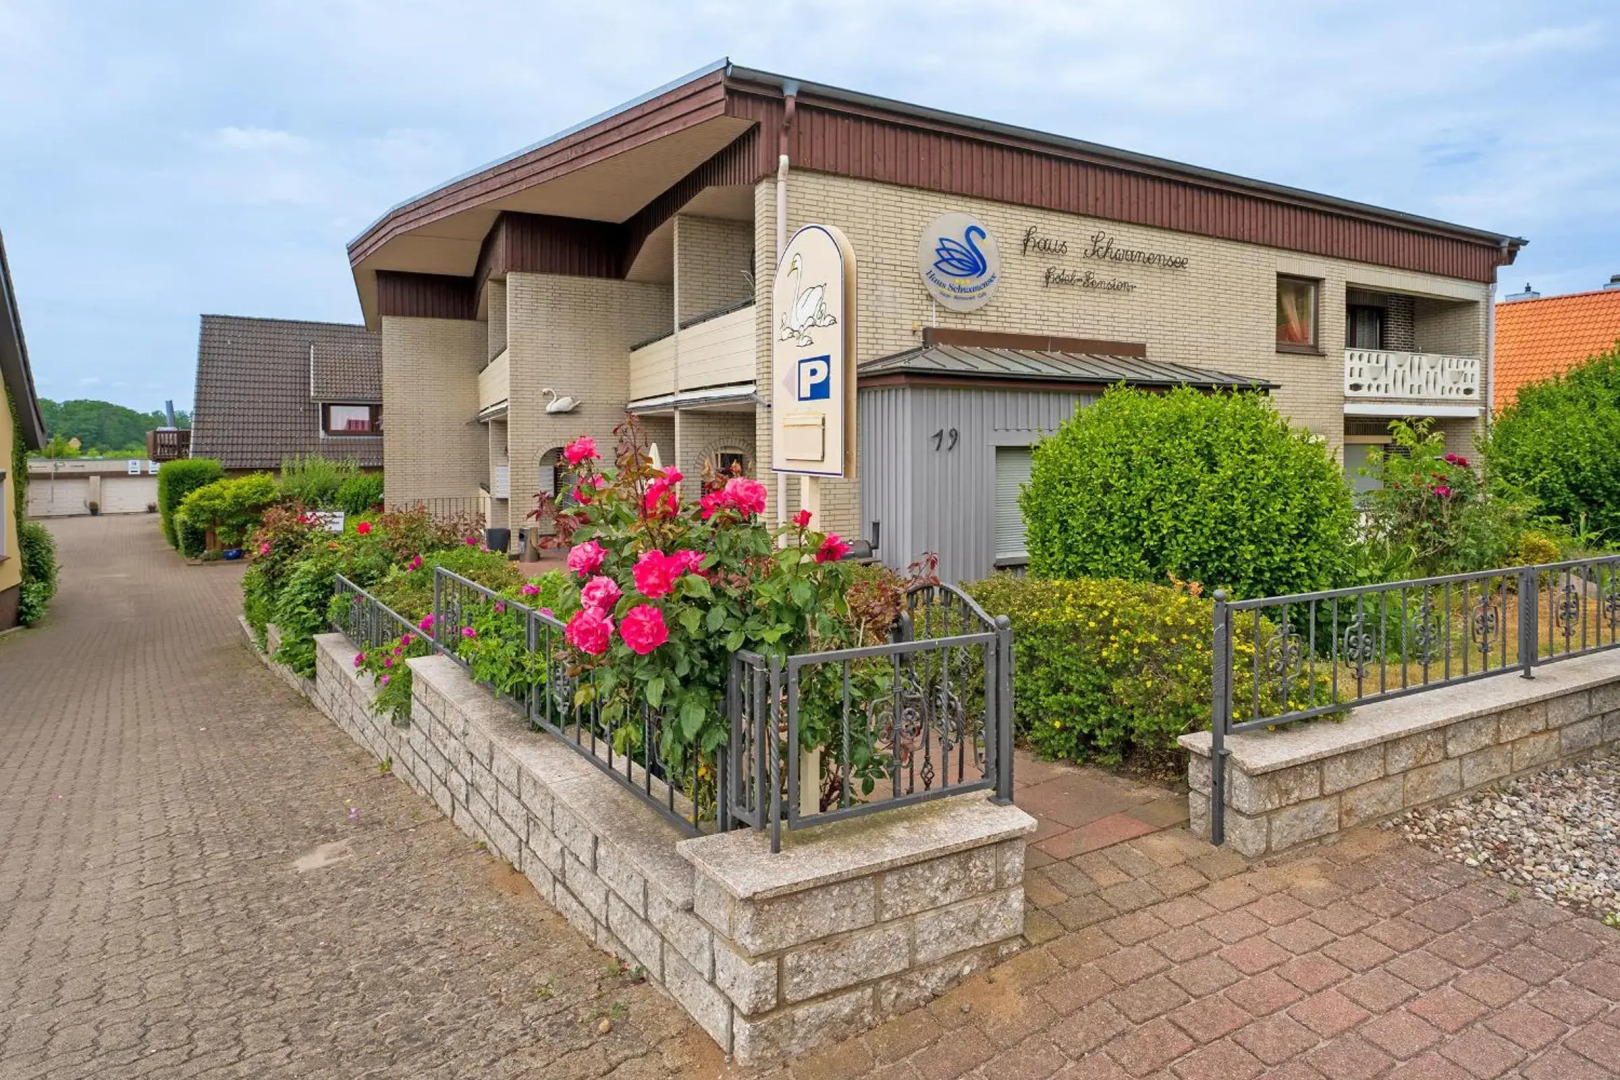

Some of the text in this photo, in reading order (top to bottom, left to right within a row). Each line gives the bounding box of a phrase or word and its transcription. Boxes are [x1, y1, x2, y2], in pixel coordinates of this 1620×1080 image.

[1083, 231, 1189, 269] Schwanensee
[926, 270, 997, 293] Haus Schwanensee
[800, 359, 828, 399] P
[931, 427, 958, 451] 19
